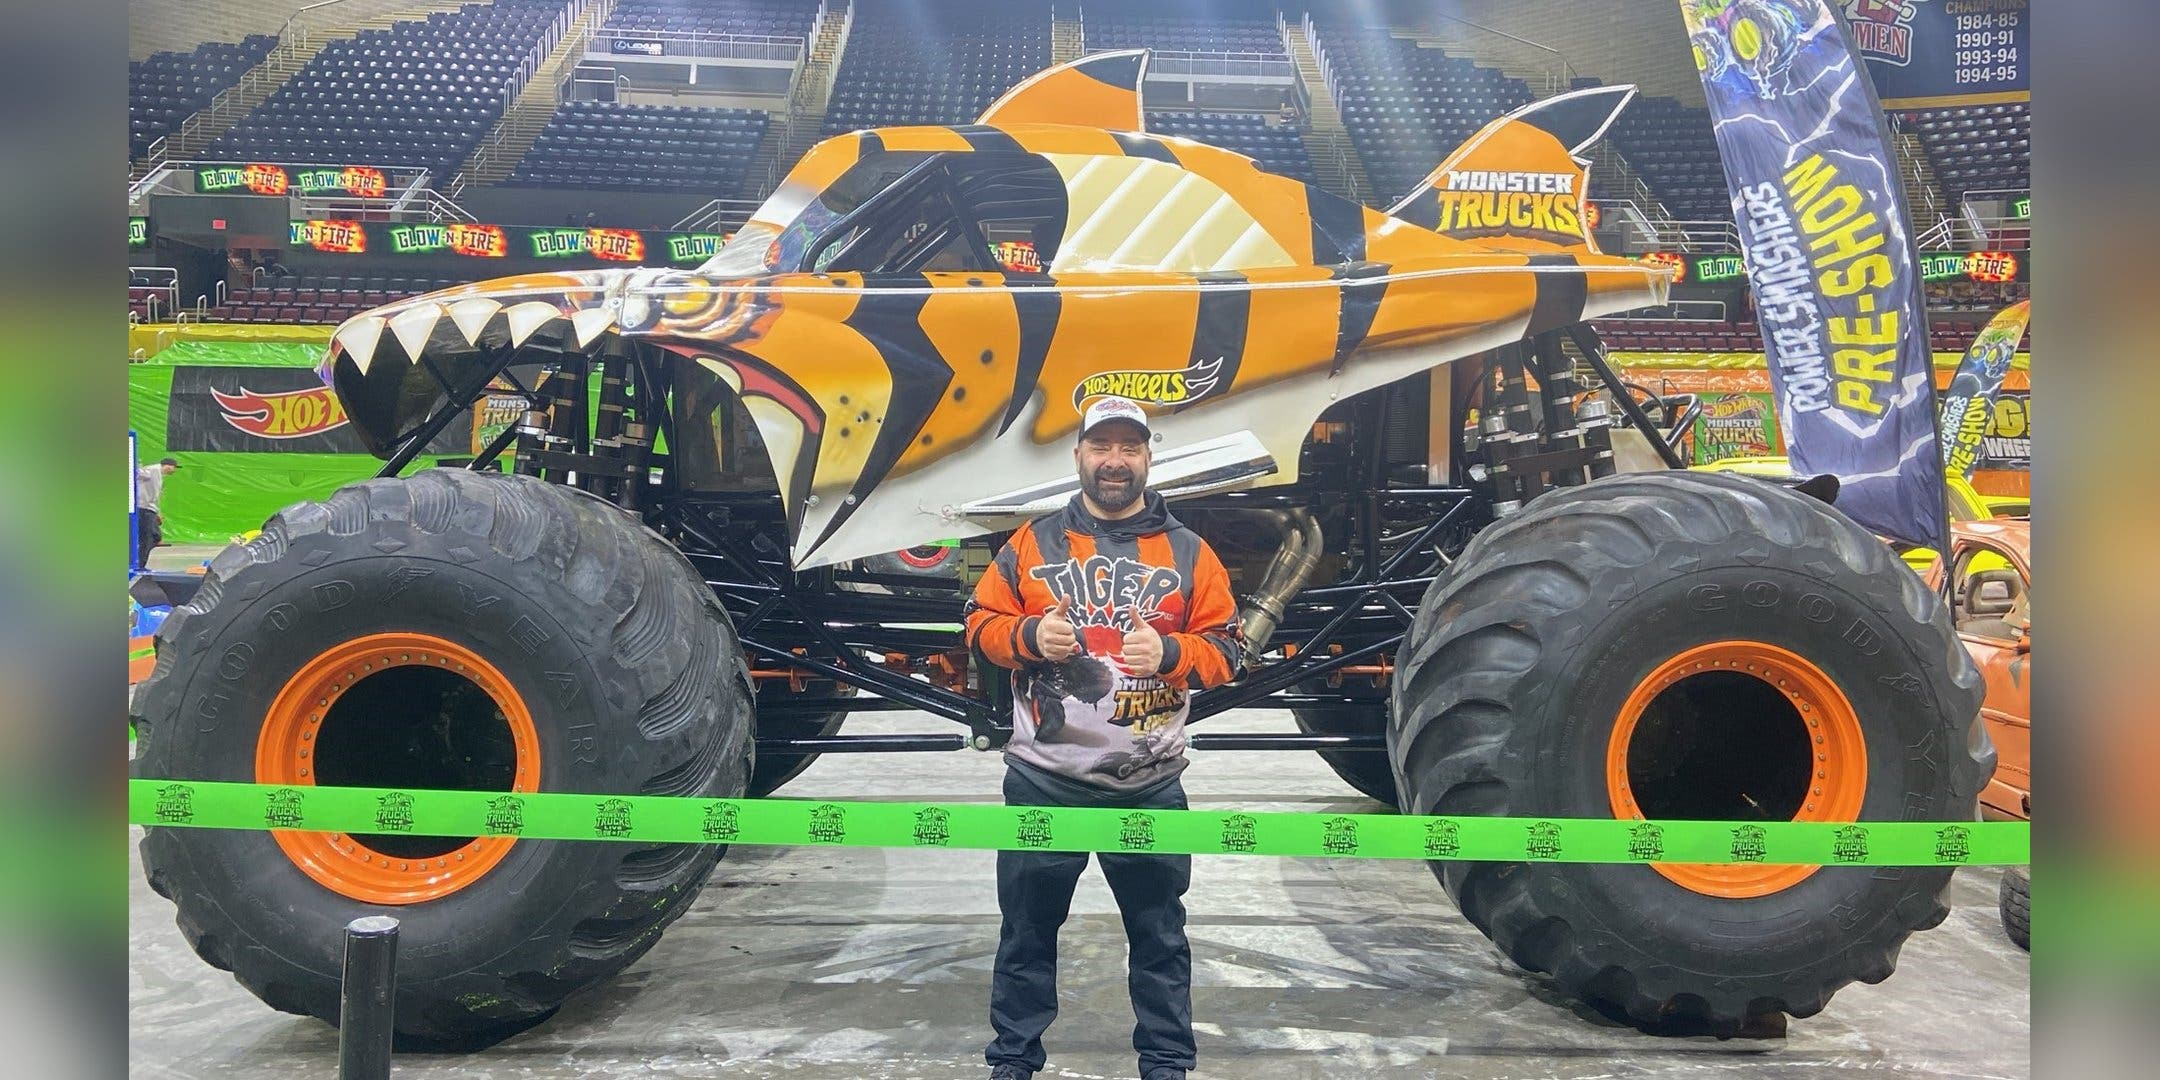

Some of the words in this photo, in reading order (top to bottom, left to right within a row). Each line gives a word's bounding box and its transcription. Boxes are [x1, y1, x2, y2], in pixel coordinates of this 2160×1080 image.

[1956, 12, 2018, 30] 1984-85
[1853, 21, 1907, 58] MEN
[1955, 30, 2014, 48] 1990-91
[1955, 48, 2017, 66] 1993-94
[1955, 66, 2017, 83] 1994-95
[1447, 171, 1575, 193] MONSTER
[1436, 190, 1586, 238] TRUCKS
[1743, 180, 1816, 325] SMASHERS
[1782, 153, 1899, 416] PRE-SHOW
[1772, 311, 1831, 414] POWER
[487, 399, 529, 408] MONS
[263, 394, 327, 434] HOT
[483, 408, 522, 425] TRU
[1706, 419, 1763, 428] MONSTER
[1704, 427, 1767, 446] TRUCKS
[1031, 555, 1181, 613] TIGER
[156, 802, 192, 813] TRUCKS
[266, 807, 301, 817] TRUCKS
[376, 811, 412, 821] TRUCKS
[487, 814, 521, 824] TRUCKS
[596, 817, 631, 827] TRUCKS
[703, 820, 737, 830] TRUCKS
[810, 823, 844, 832] TRUCKS
[914, 826, 948, 836] TRUCKS
[1017, 828, 1051, 837] TRUCKS
[1120, 830, 1153, 840] TRUCKS
[1222, 832, 1255, 842] TRUCKS
[1324, 835, 1357, 844] TRUCKS
[1425, 837, 1458, 846] TRUCKS
[1527, 839, 1560, 849] TRUCKS
[1629, 841, 1663, 850] TRUCKS
[1732, 842, 1765, 852] TRUCKS
[1834, 843, 1867, 852] TRUCKS
[1936, 843, 1968, 852] TRUCKS
